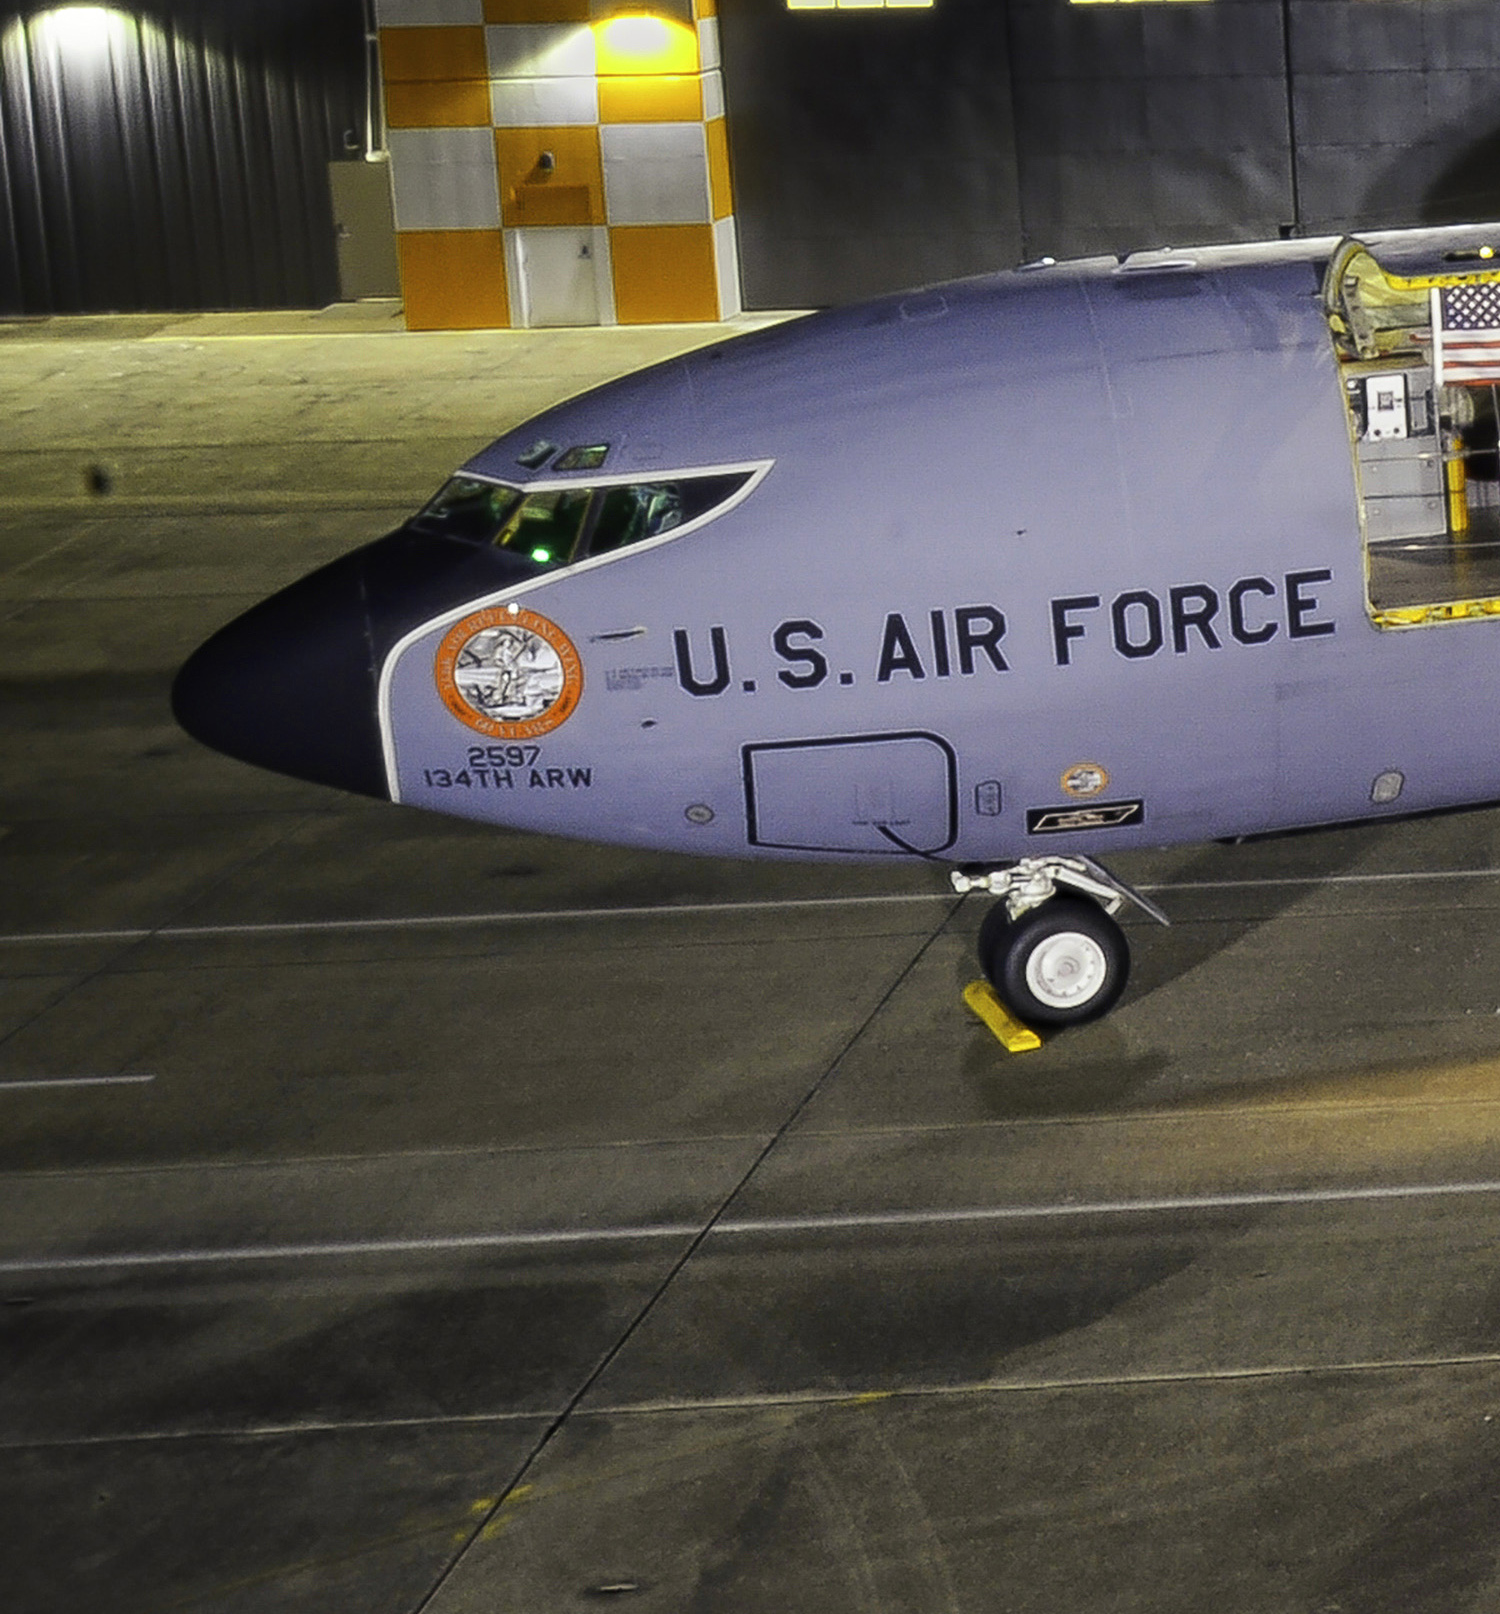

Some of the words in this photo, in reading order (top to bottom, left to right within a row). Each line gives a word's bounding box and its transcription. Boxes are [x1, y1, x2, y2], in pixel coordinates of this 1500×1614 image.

[877, 604, 1010, 682] AIR
[1050, 568, 1336, 666] FORCE
[467, 746, 541, 767] 2597
[424, 768, 514, 789] 134TH
[529, 768, 592, 789] ARW
